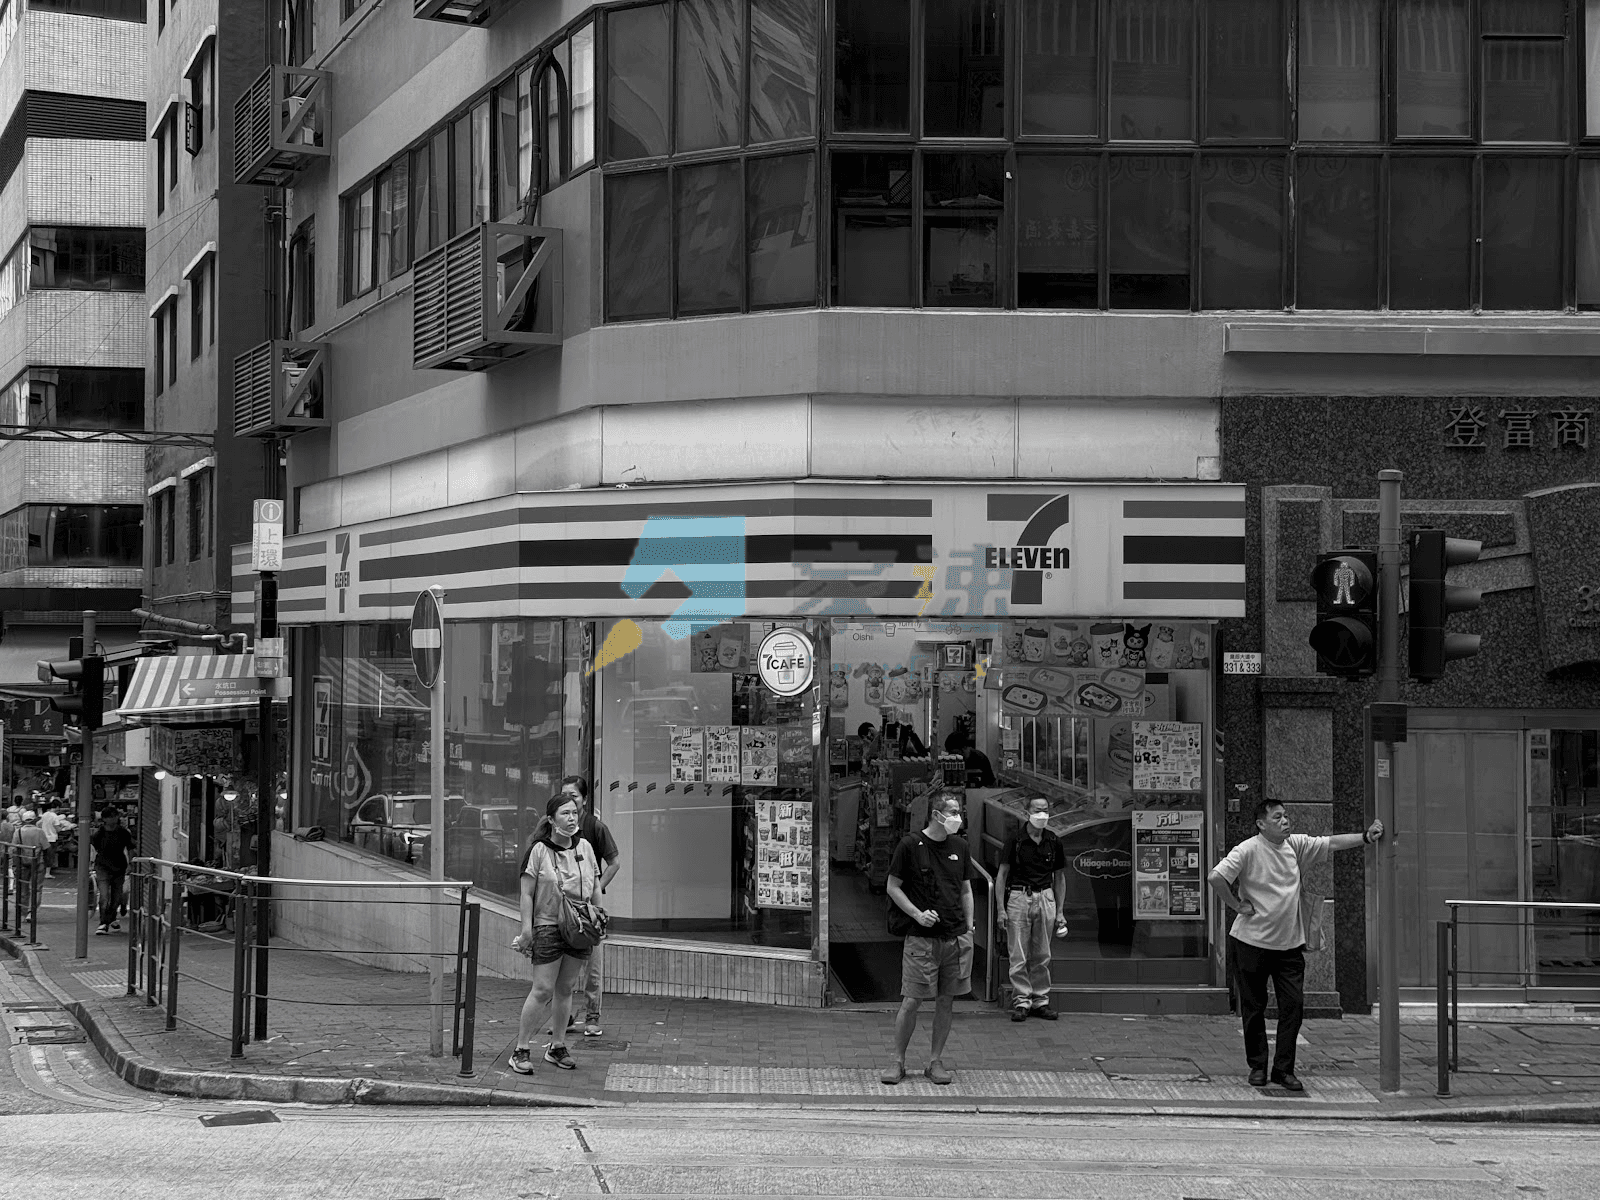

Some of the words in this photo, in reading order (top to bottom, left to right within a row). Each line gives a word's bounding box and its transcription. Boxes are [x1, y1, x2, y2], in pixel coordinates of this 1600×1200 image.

[1443, 405, 1593, 450] 登富商
[260, 528, 279, 567] 上環
[1224, 662, 1238, 673] 331
[1239, 662, 1245, 673] &
[1246, 662, 1261, 673] 333
[1157, 812, 1180, 827] 方便
